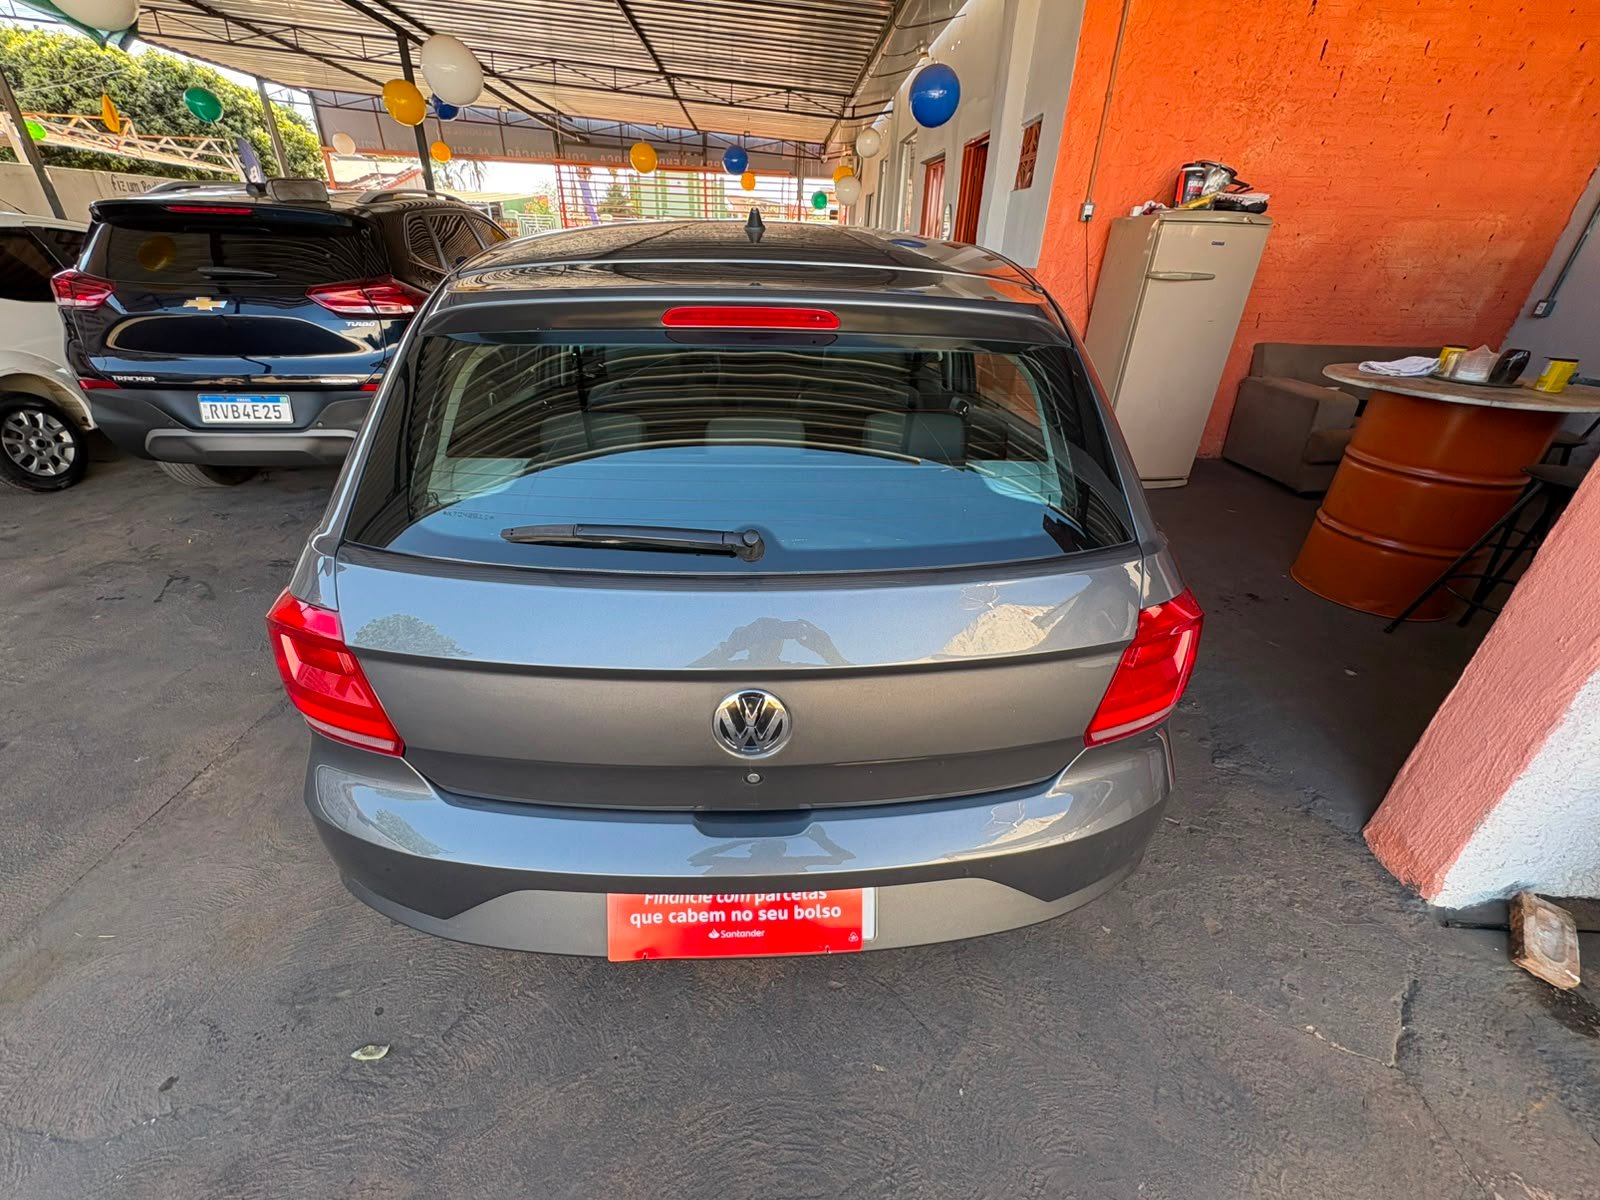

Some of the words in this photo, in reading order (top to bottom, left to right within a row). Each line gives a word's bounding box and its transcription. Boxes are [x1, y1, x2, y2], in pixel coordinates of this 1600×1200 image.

[209, 404, 282, 420] RVB4E25
[716, 893, 751, 904] com
[755, 890, 827, 906] parcelas
[630, 912, 663, 928] que
[668, 908, 726, 924] cabem
[731, 908, 754, 922] no
[757, 907, 788, 921] seu
[793, 904, 842, 920] bolso
[720, 929, 765, 939] Santander
